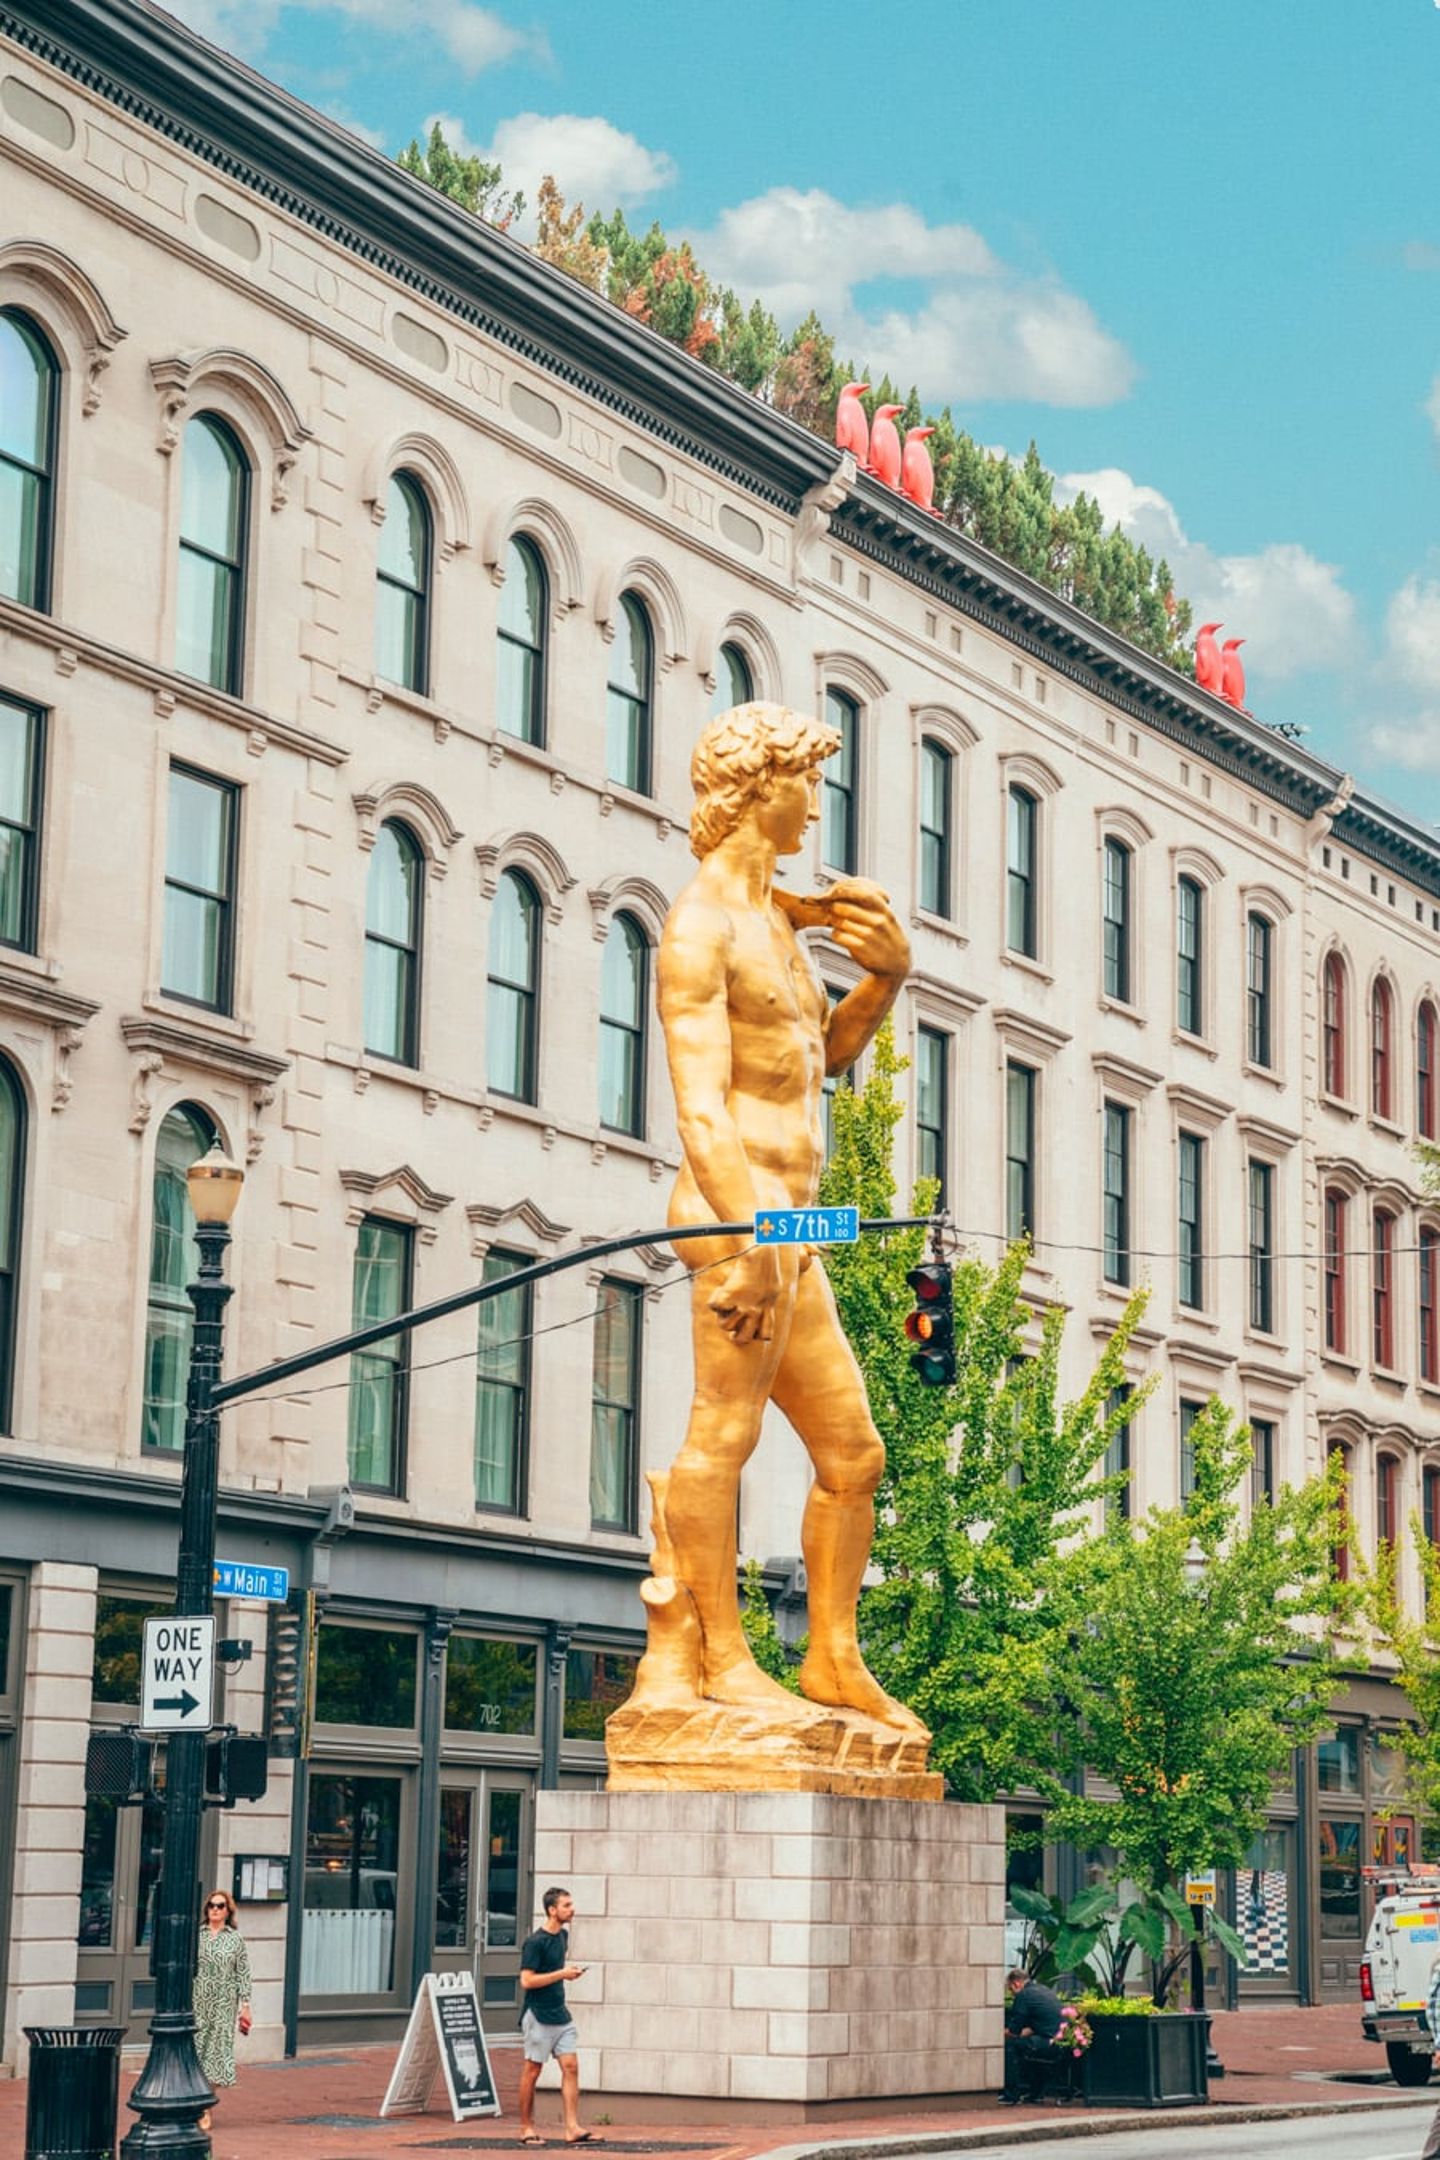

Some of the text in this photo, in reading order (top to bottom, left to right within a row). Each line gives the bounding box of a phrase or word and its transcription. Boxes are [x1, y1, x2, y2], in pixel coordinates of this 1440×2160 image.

[778, 1212, 849, 1239] S 7th St
[834, 1228, 849, 1238] 100
[223, 1570, 233, 1586] W
[234, 1567, 267, 1595] Main
[156, 1626, 202, 1652] ONE
[153, 1656, 203, 1682] WAY
[480, 1703, 501, 1725] 702
